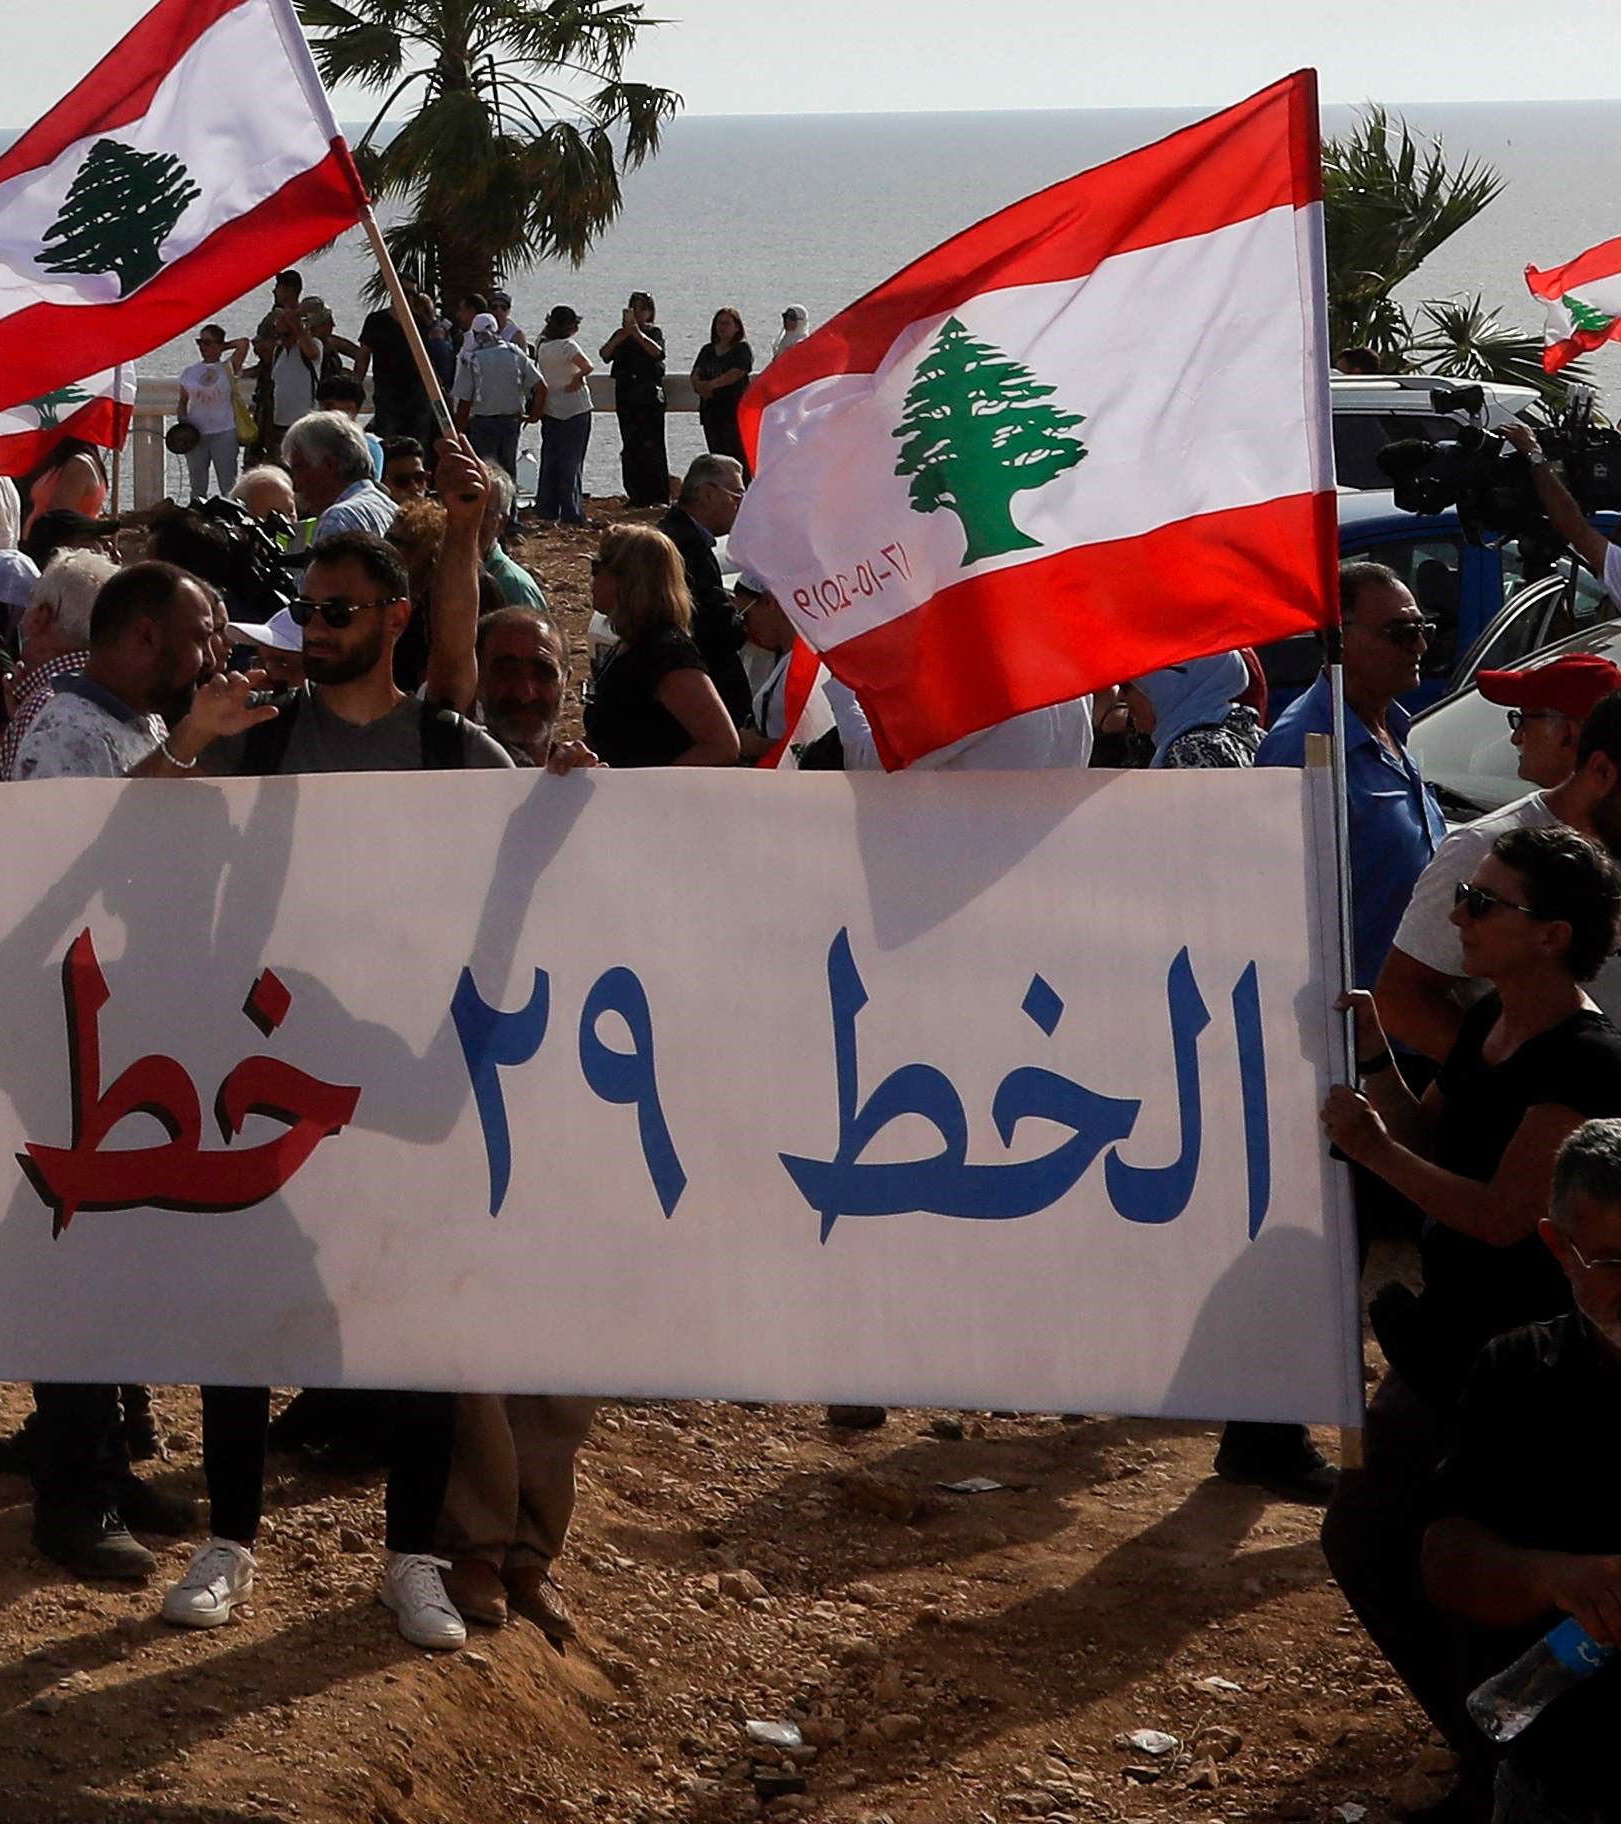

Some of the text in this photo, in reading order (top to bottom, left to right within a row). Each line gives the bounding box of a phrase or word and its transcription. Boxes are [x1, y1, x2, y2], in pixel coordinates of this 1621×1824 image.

[16, 927, 361, 1240] خط
[449, 964, 686, 1217] ٢٩
[778, 927, 1272, 1244] الخط
